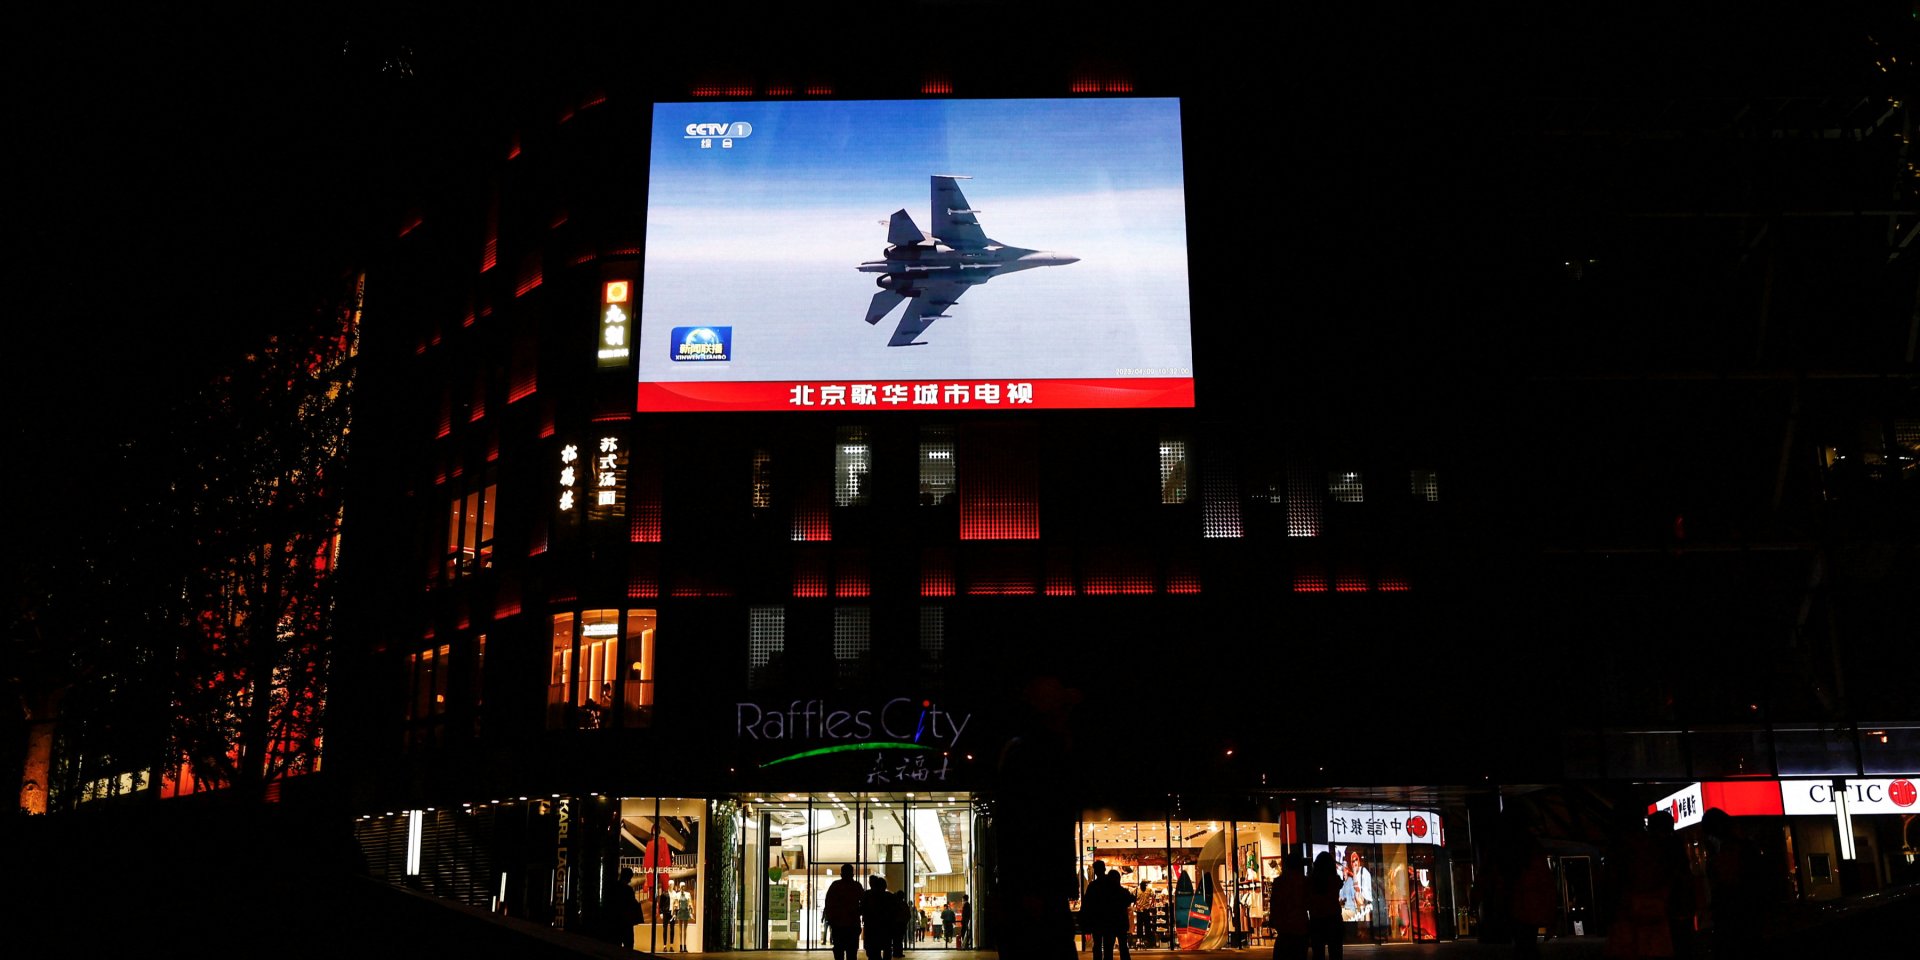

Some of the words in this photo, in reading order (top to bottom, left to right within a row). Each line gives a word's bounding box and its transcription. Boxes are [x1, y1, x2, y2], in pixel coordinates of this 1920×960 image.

[686, 123, 729, 136] CCTV
[737, 124, 744, 136] 1
[701, 138, 733, 149] 综合
[790, 382, 1033, 406] 北京歌华城市电视
[598, 437, 618, 506] 苏式汤面
[733, 699, 873, 740] Raffles
[881, 697, 971, 748] City
[867, 752, 951, 784] 来福士
[558, 799, 570, 845] KARL
[554, 847, 568, 928] LAGERFE
